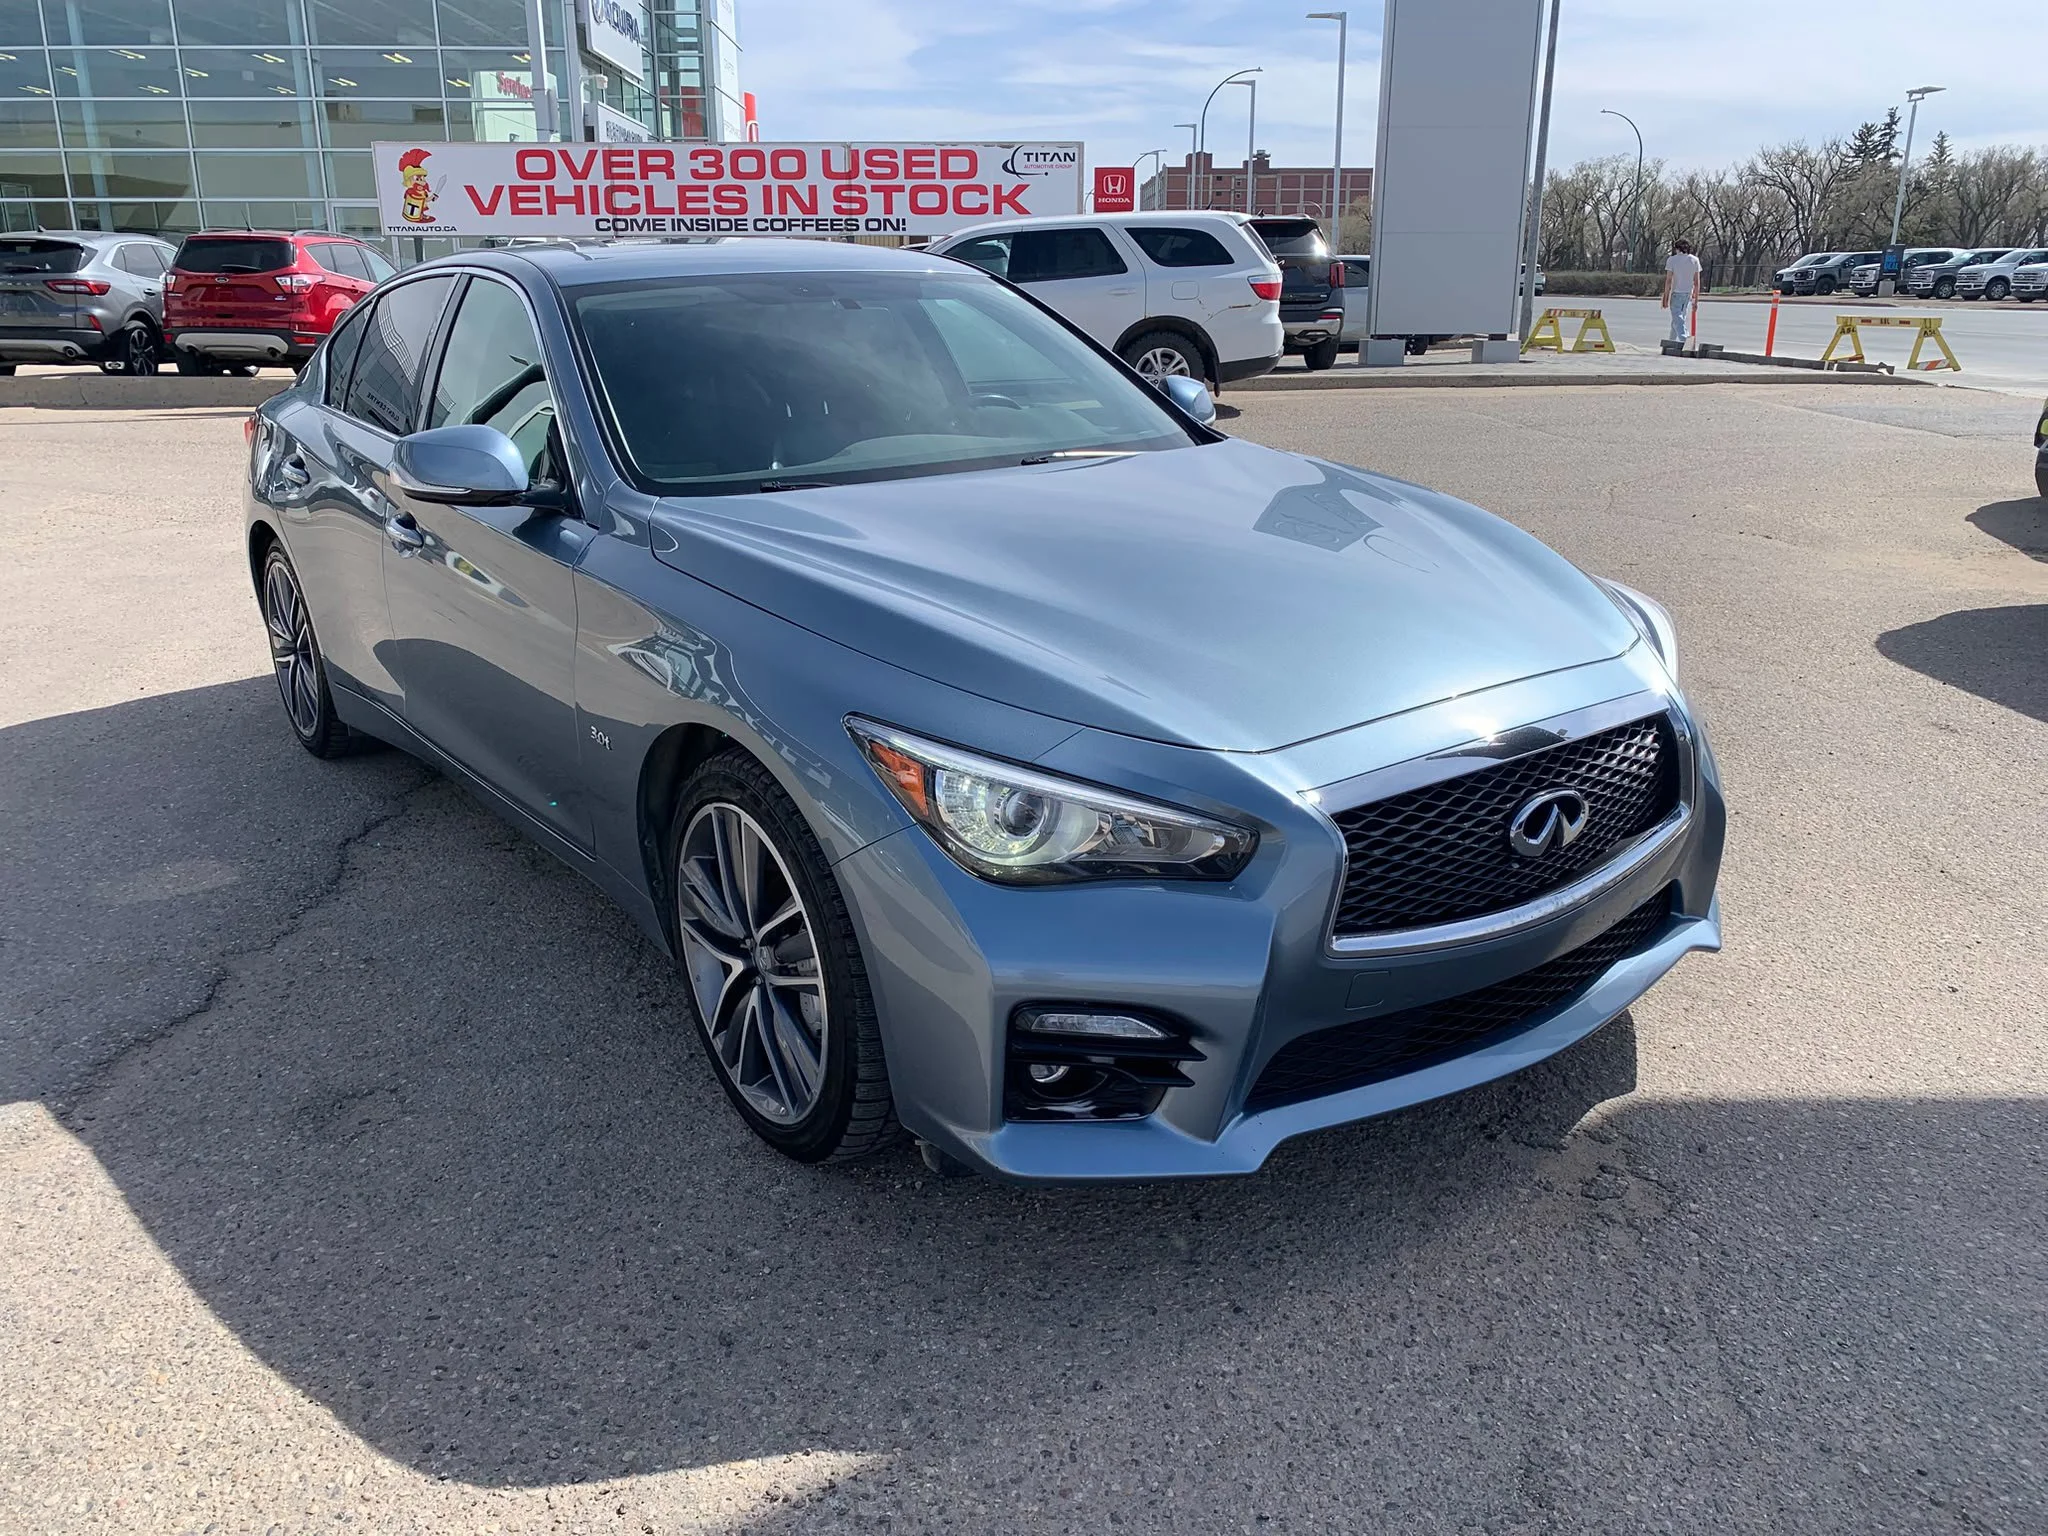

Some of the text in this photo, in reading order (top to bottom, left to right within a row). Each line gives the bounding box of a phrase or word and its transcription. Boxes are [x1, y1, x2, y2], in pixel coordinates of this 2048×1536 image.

[516, 148, 978, 181] OVER 300 USED
[1023, 152, 1076, 162] TITAN
[463, 184, 1032, 216] VEHICLES IN STOCK
[407, 202, 420, 217] T
[595, 218, 907, 232] COME INSIDE COFFEES ON!
